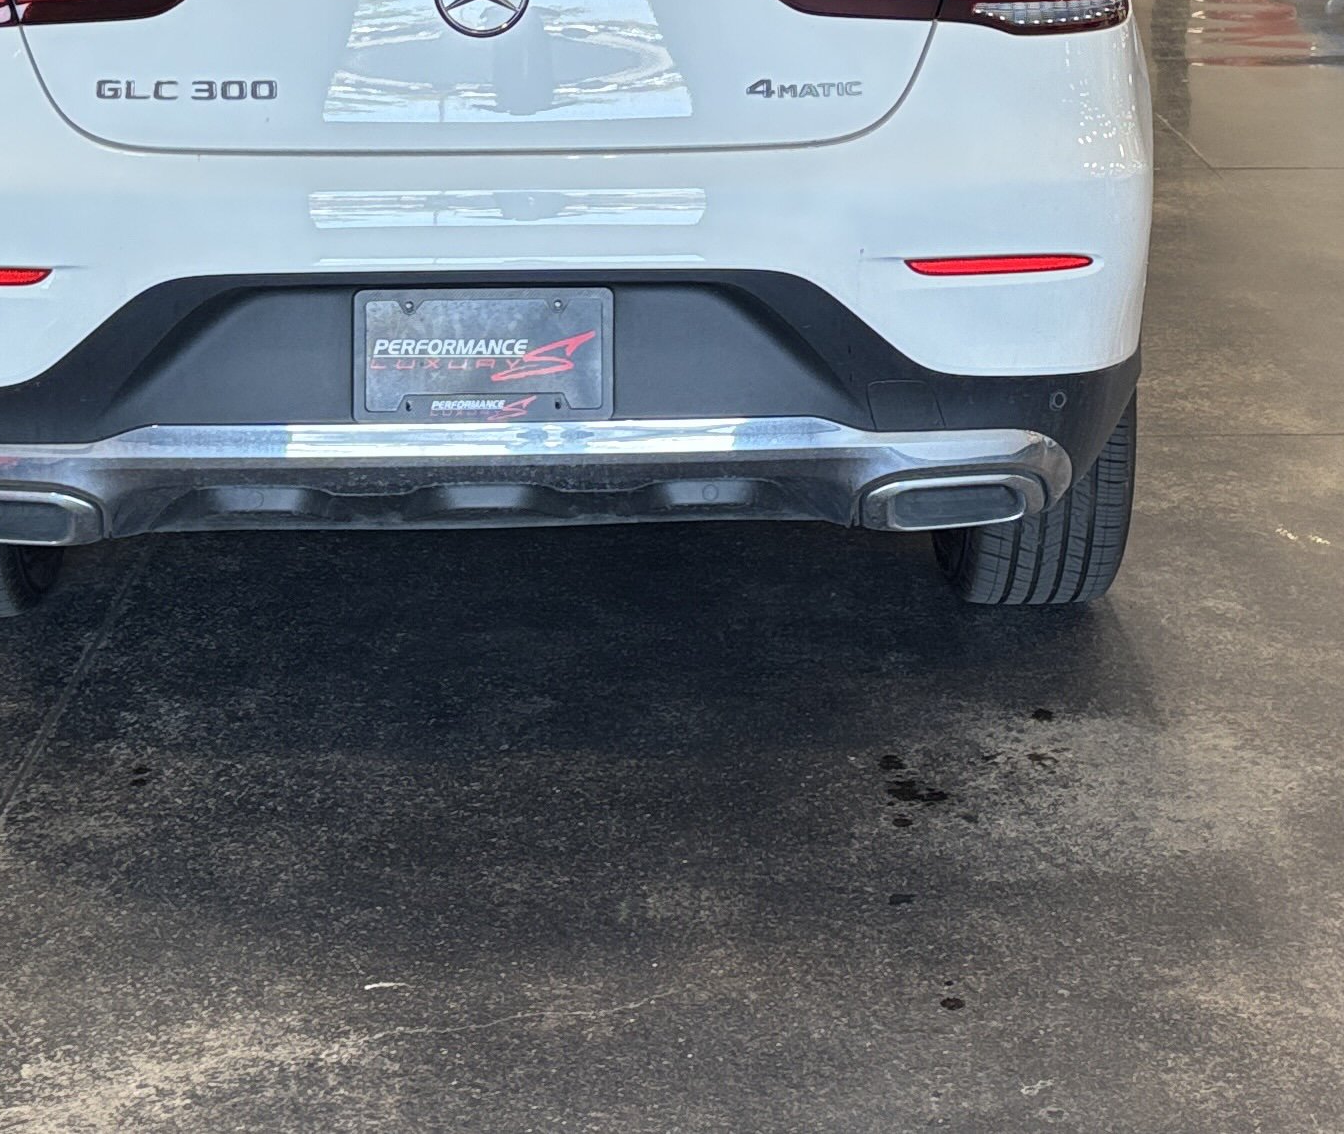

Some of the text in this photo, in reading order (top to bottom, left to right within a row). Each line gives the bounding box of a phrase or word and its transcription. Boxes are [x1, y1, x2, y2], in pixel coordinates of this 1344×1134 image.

[96, 79, 278, 101] GLC 300
[745, 78, 863, 99] 4MATIC
[373, 338, 529, 355] PERFORMANCE
[431, 399, 506, 411] PERFORMANCE
